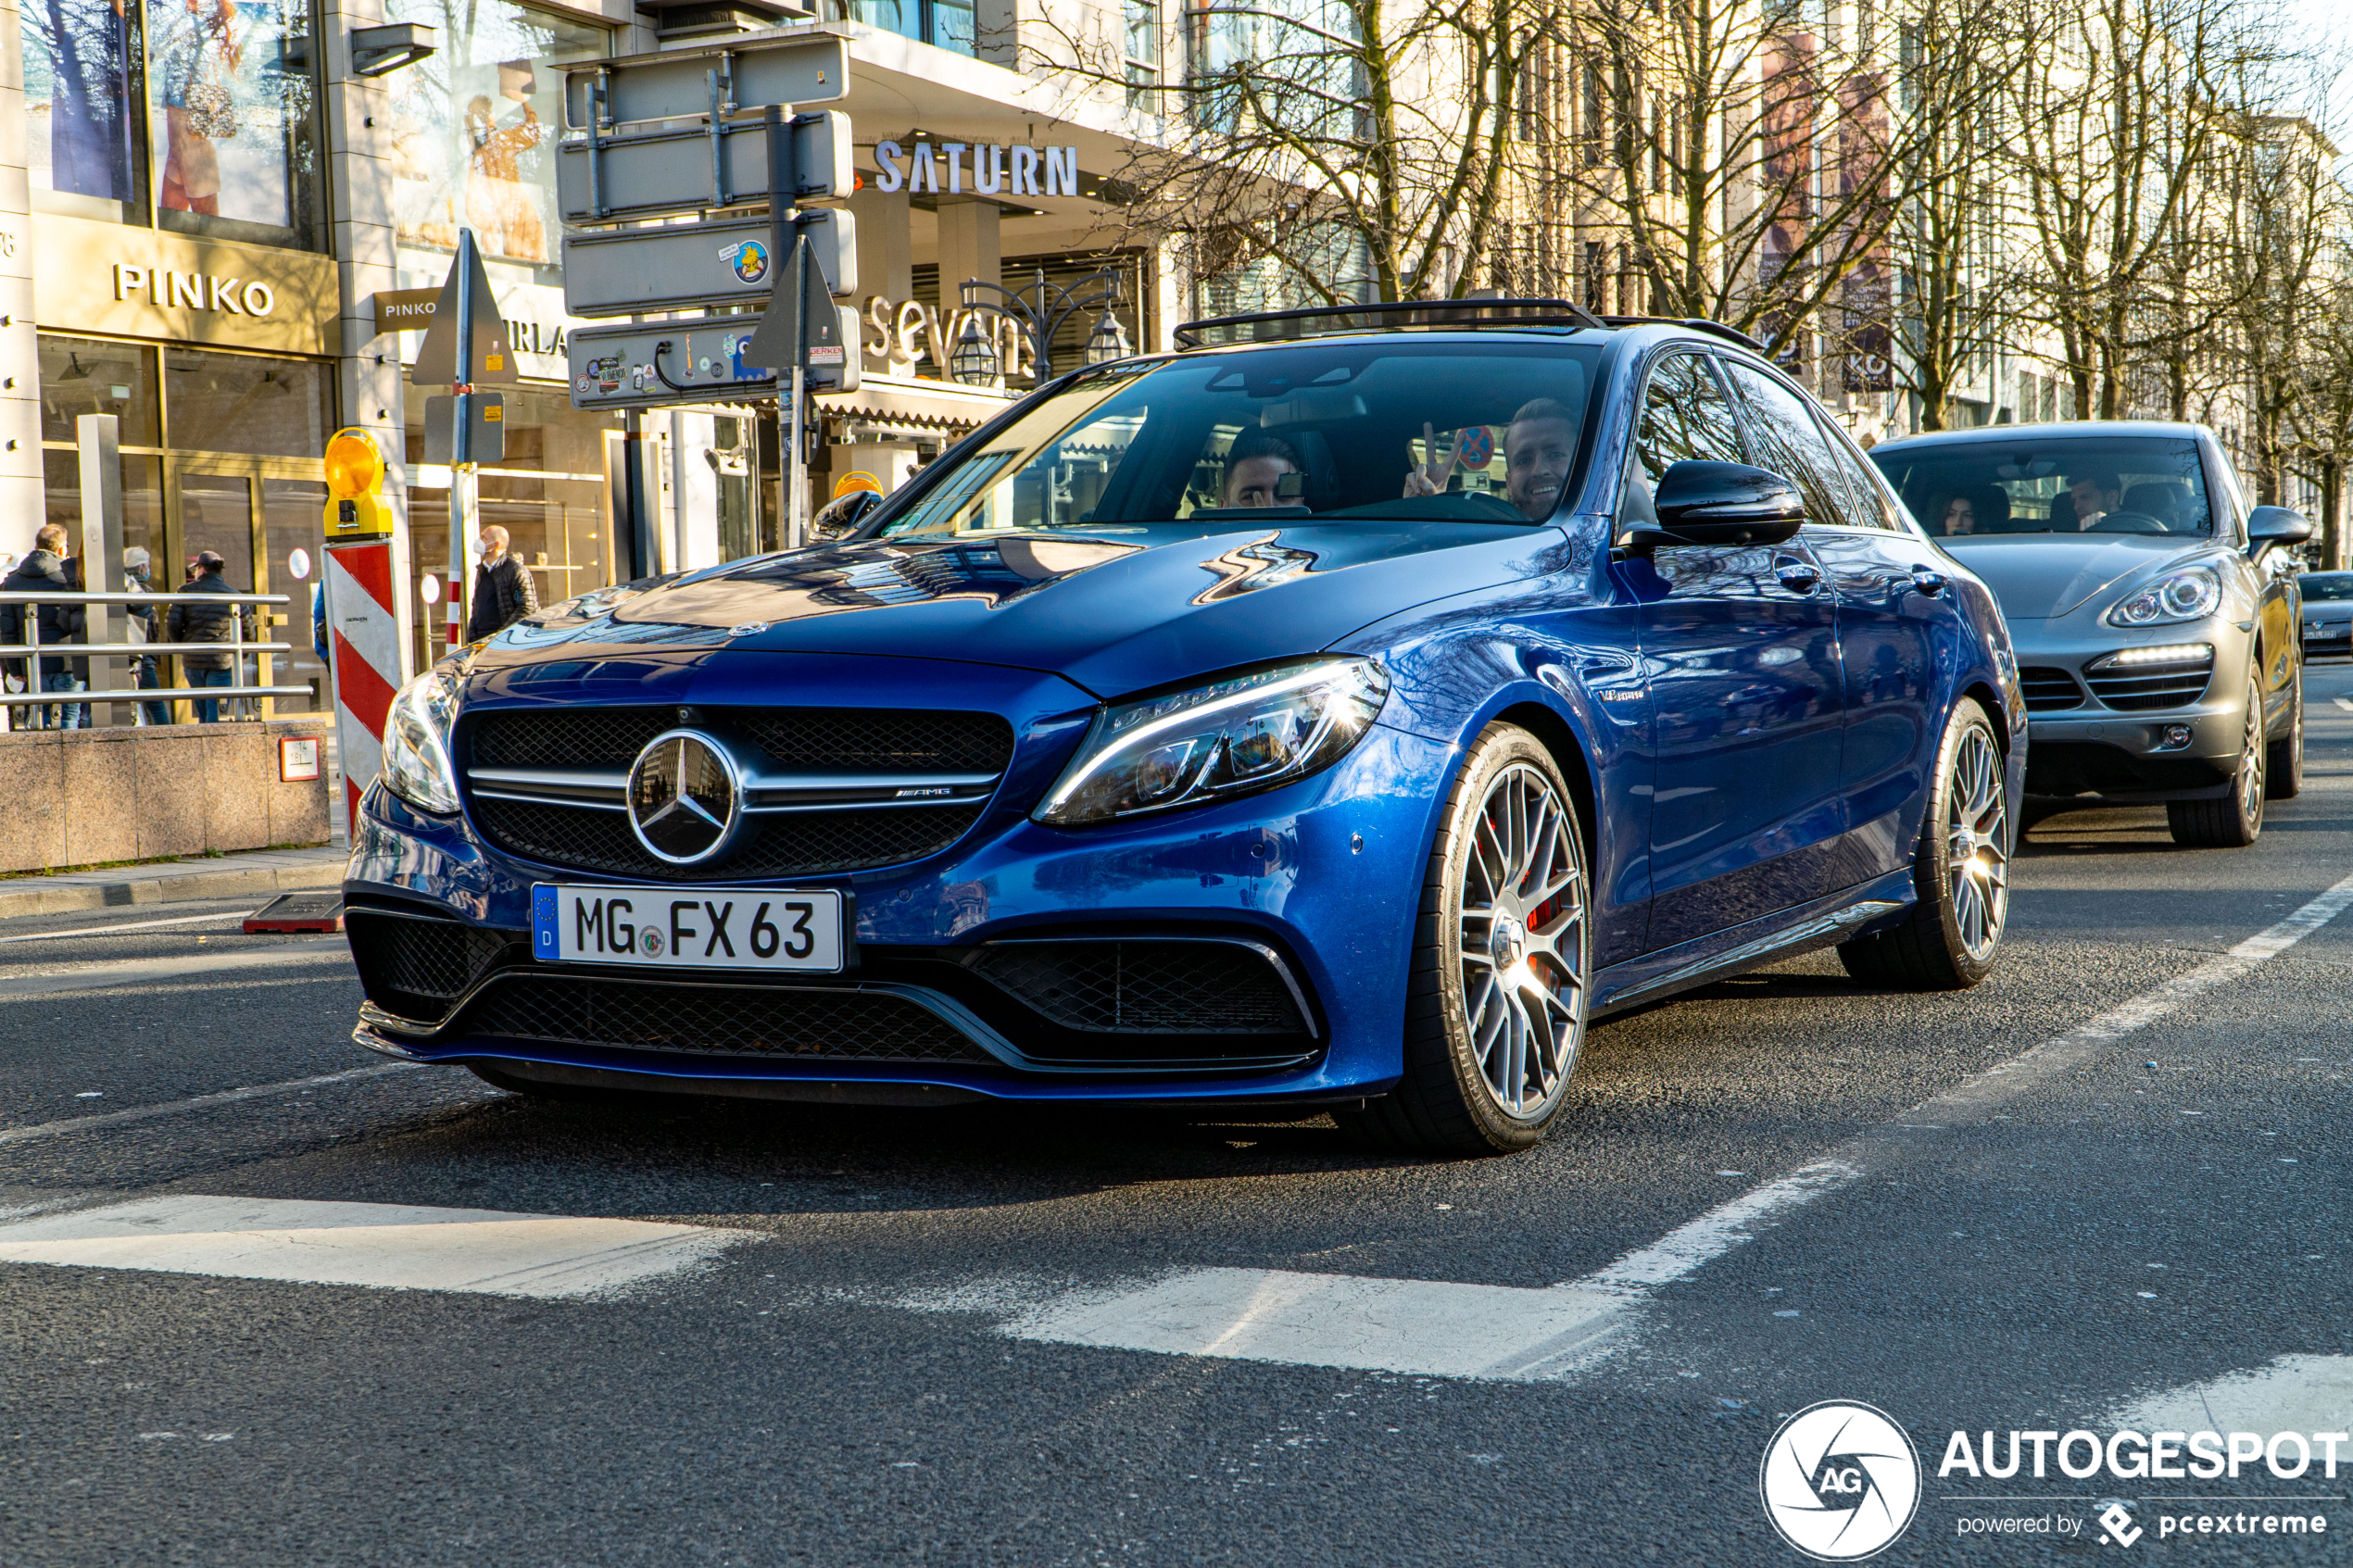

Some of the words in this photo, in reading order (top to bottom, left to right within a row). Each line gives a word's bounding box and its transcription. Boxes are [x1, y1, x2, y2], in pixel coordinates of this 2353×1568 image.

[874, 140, 1077, 196] SATURN
[113, 264, 274, 317] PINKO
[385, 302, 436, 317] PINKO
[542, 931, 552, 947] D
[575, 897, 635, 954] MG
[670, 900, 736, 958] FX
[749, 901, 815, 959] 63
